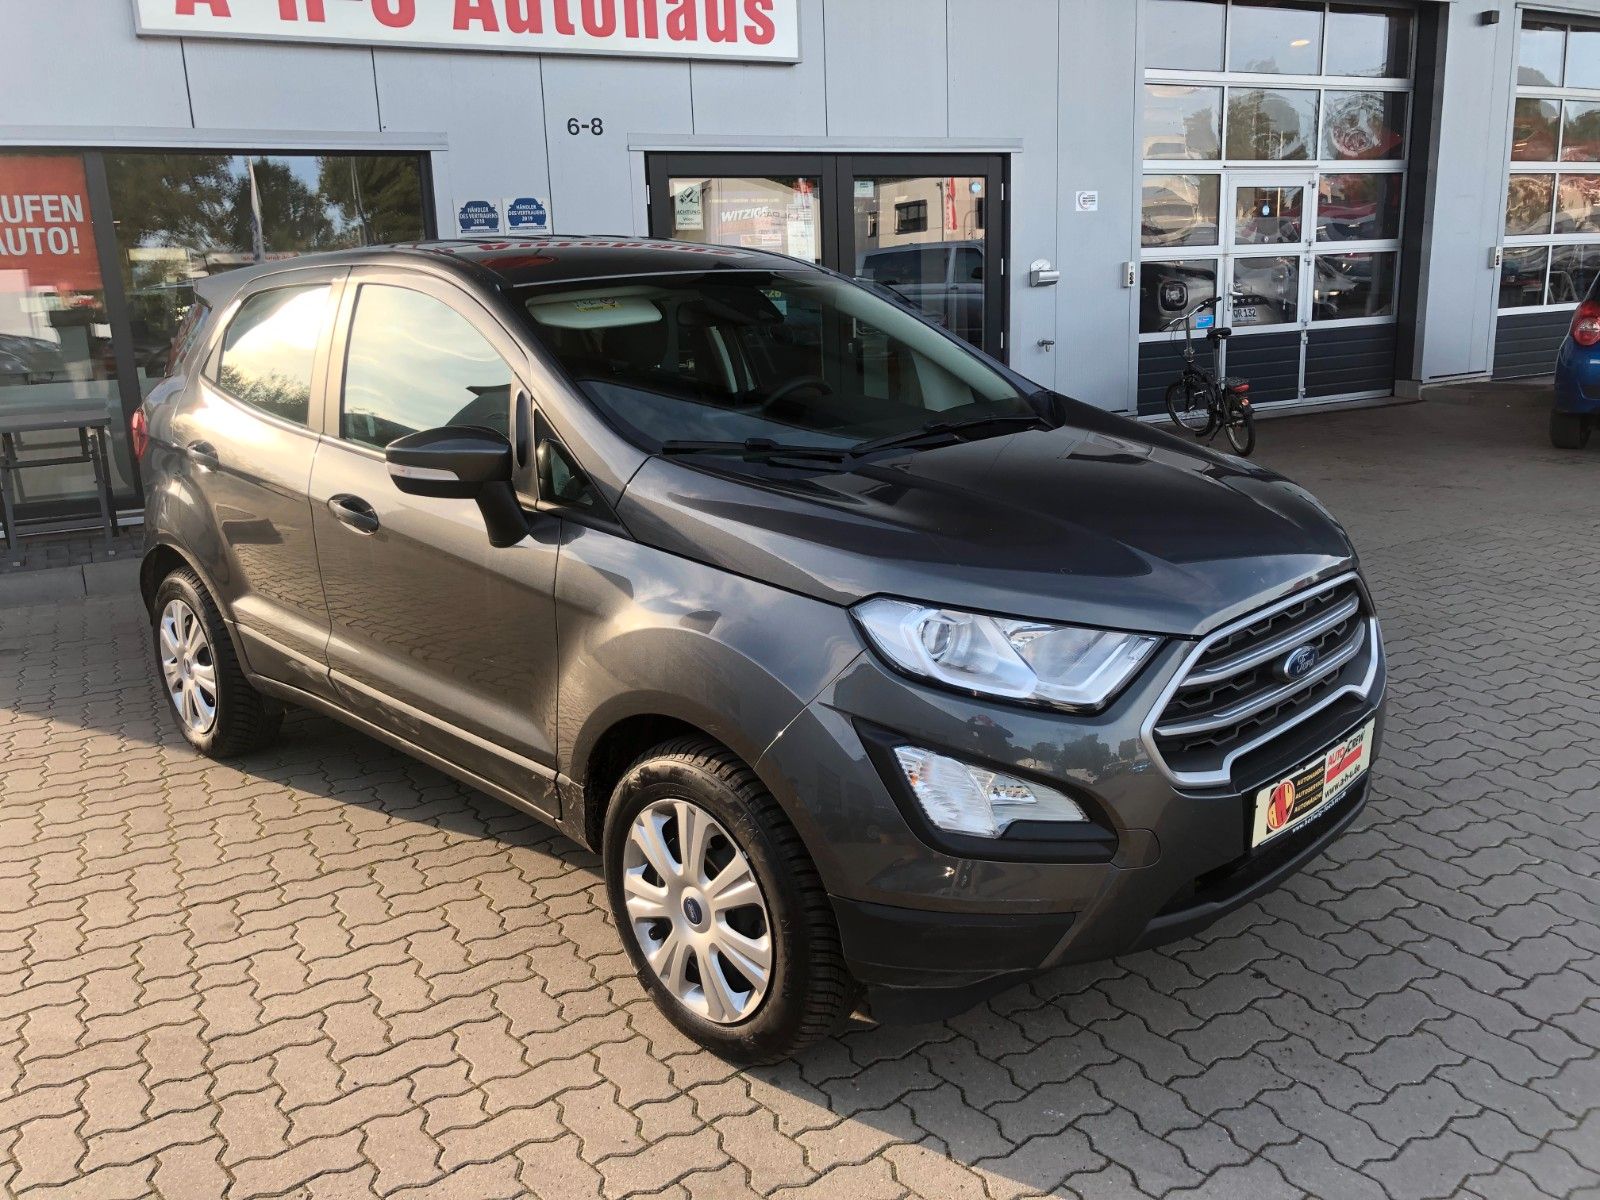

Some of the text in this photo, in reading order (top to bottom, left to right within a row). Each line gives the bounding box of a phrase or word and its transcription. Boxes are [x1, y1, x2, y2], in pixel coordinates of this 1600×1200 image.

[567, 117, 604, 136] 6-8
[0, 194, 84, 223] UFEN
[1295, 651, 1316, 674] Ford
